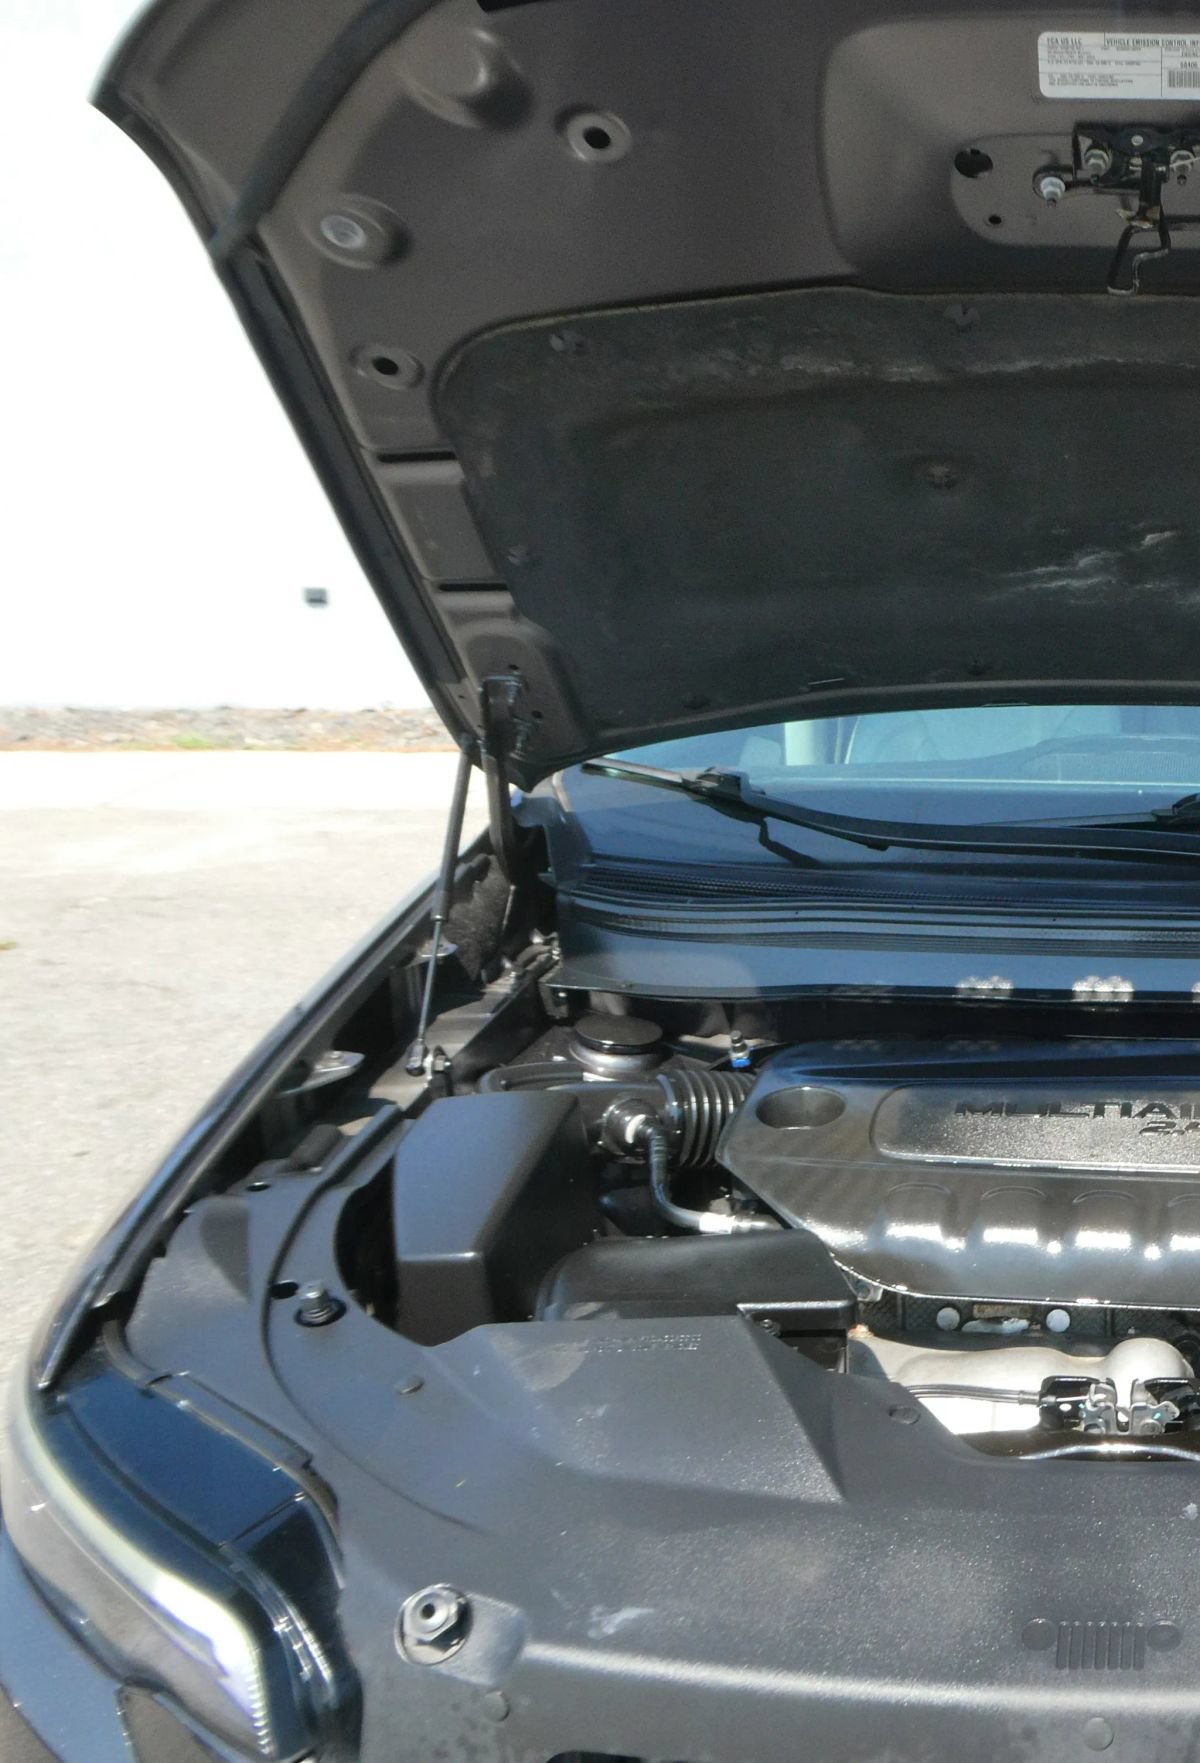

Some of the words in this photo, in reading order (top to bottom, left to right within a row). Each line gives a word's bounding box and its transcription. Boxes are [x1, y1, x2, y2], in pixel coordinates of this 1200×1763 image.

[1060, 38, 1070, 46] US
[1071, 38, 1082, 46] LLC
[1106, 38, 1130, 47] VEHICLE
[1132, 39, 1160, 47] EMISSION
[1162, 39, 1187, 48] CONTROL
